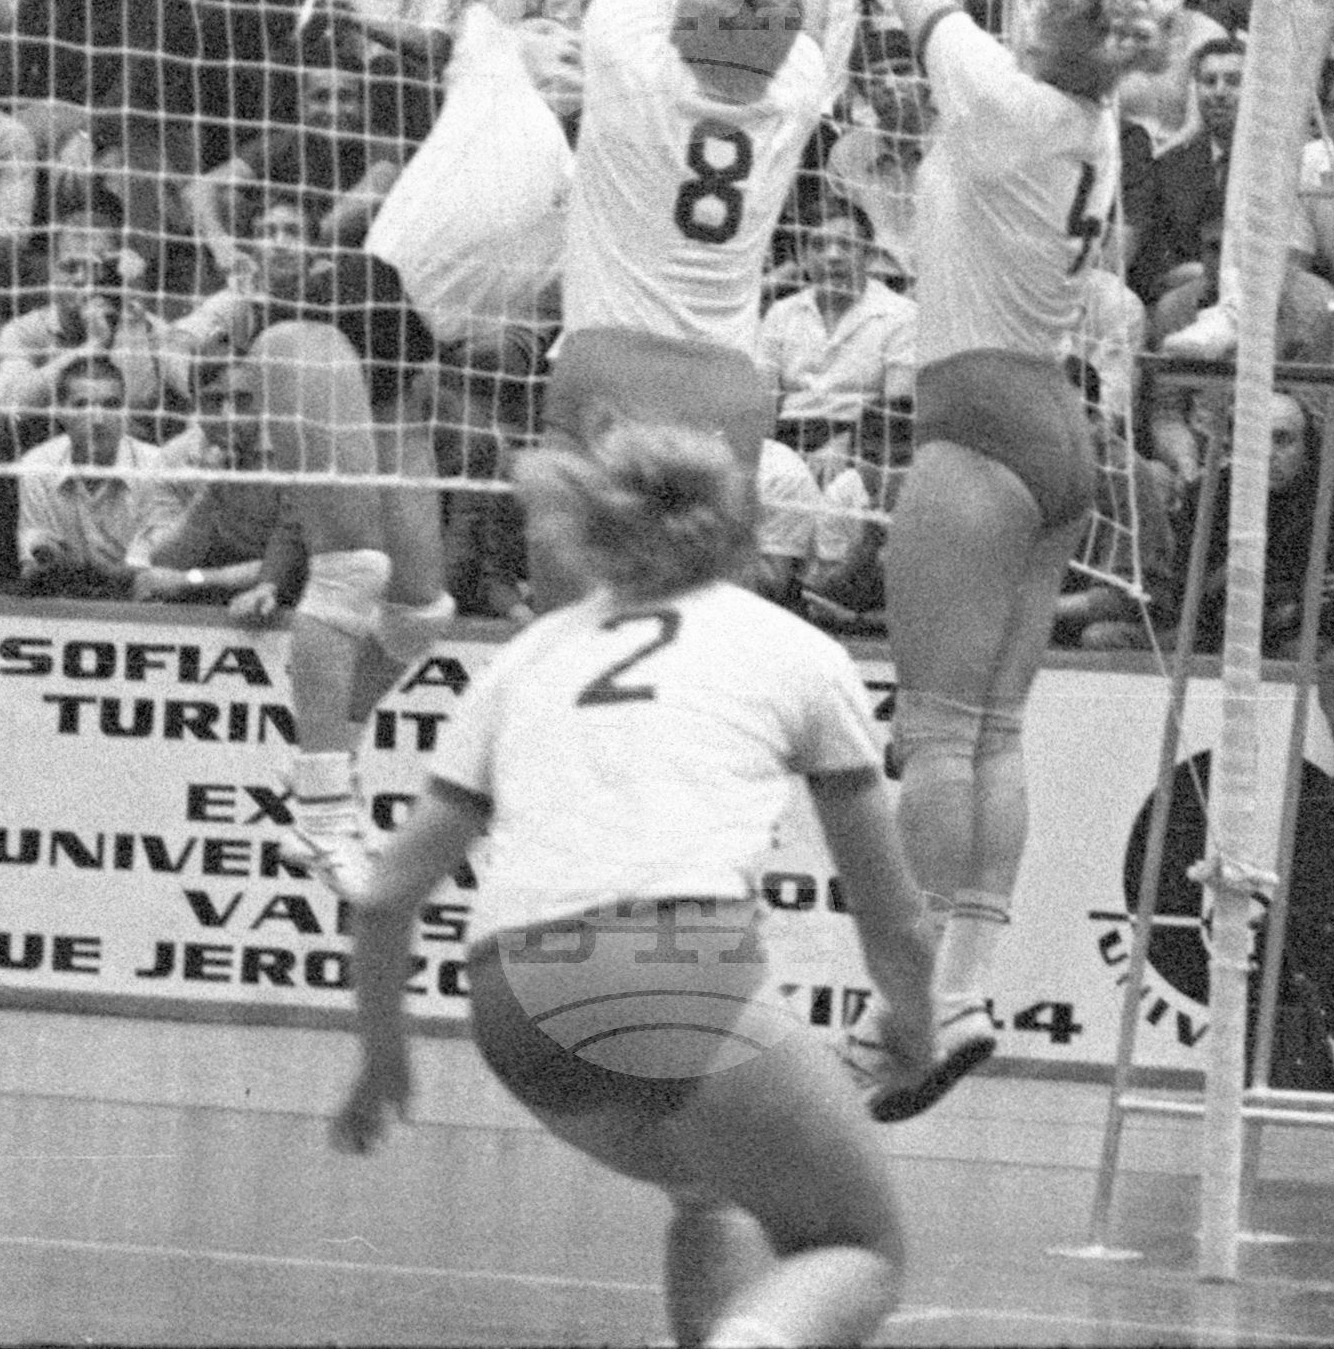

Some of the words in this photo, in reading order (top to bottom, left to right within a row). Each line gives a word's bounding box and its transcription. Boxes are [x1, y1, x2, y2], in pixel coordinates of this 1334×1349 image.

[673, 117, 753, 244] 8
[576, 610, 681, 706] 2
[43, 693, 301, 746] TURIN
